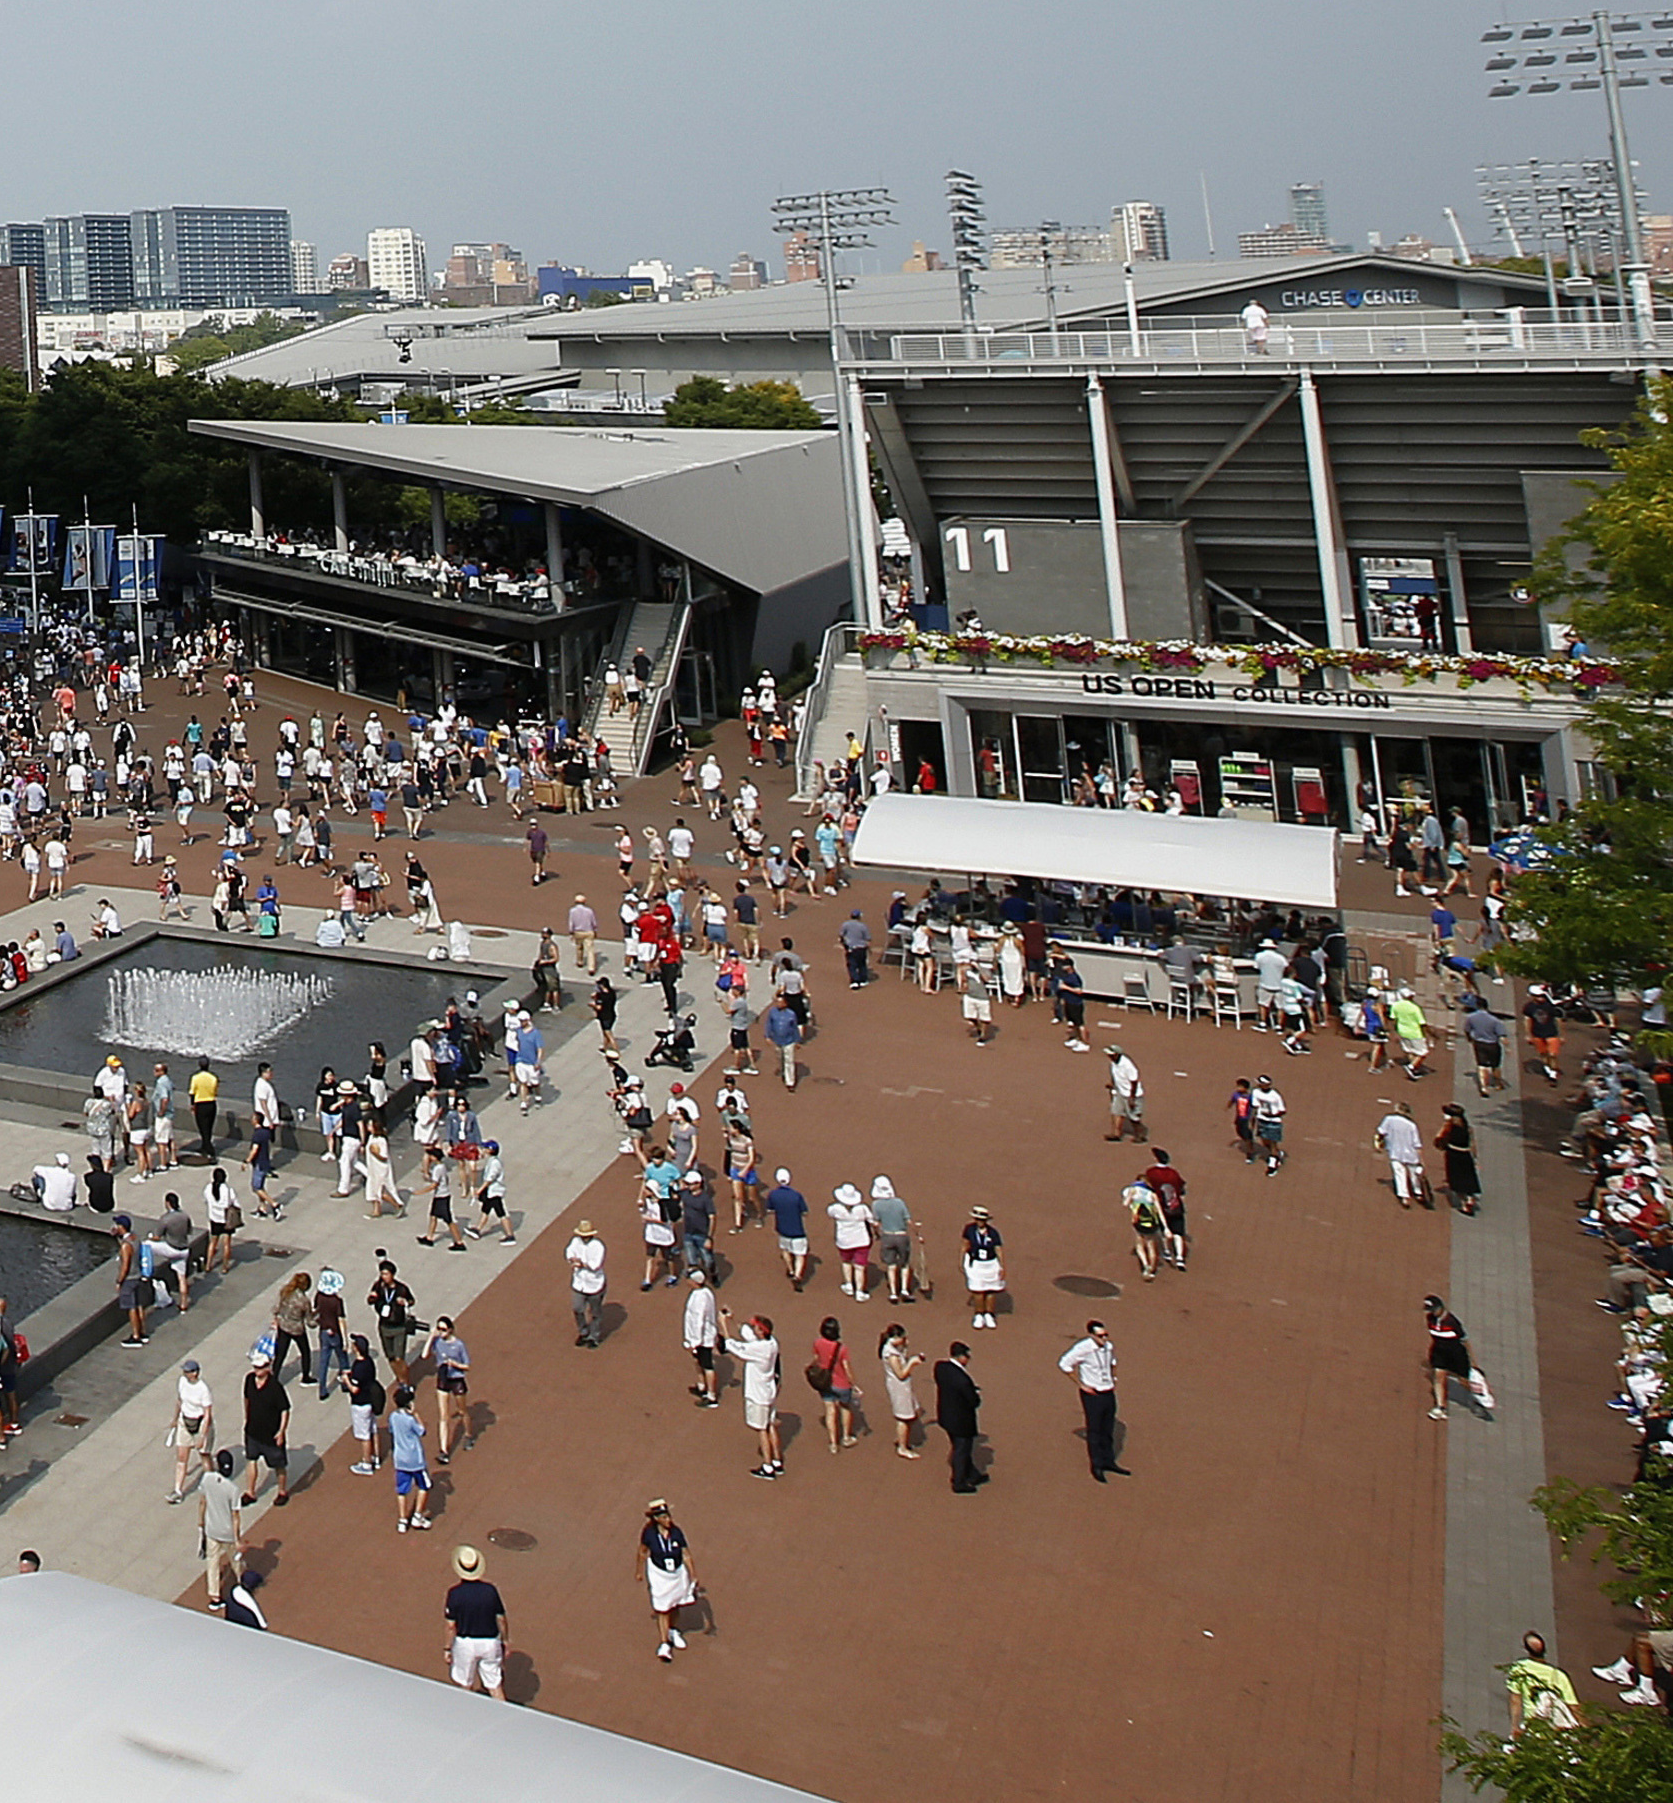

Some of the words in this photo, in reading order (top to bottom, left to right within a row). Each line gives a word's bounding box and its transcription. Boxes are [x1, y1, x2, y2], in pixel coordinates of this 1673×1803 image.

[1282, 290, 1344, 306] CHASE
[1363, 289, 1421, 305] CENTER
[945, 527, 1010, 573] 11
[1082, 674, 1123, 695] US
[1131, 677, 1216, 700] OPEN
[1233, 687, 1390, 709] COLLECTION
[889, 725, 902, 762] WOMEN
